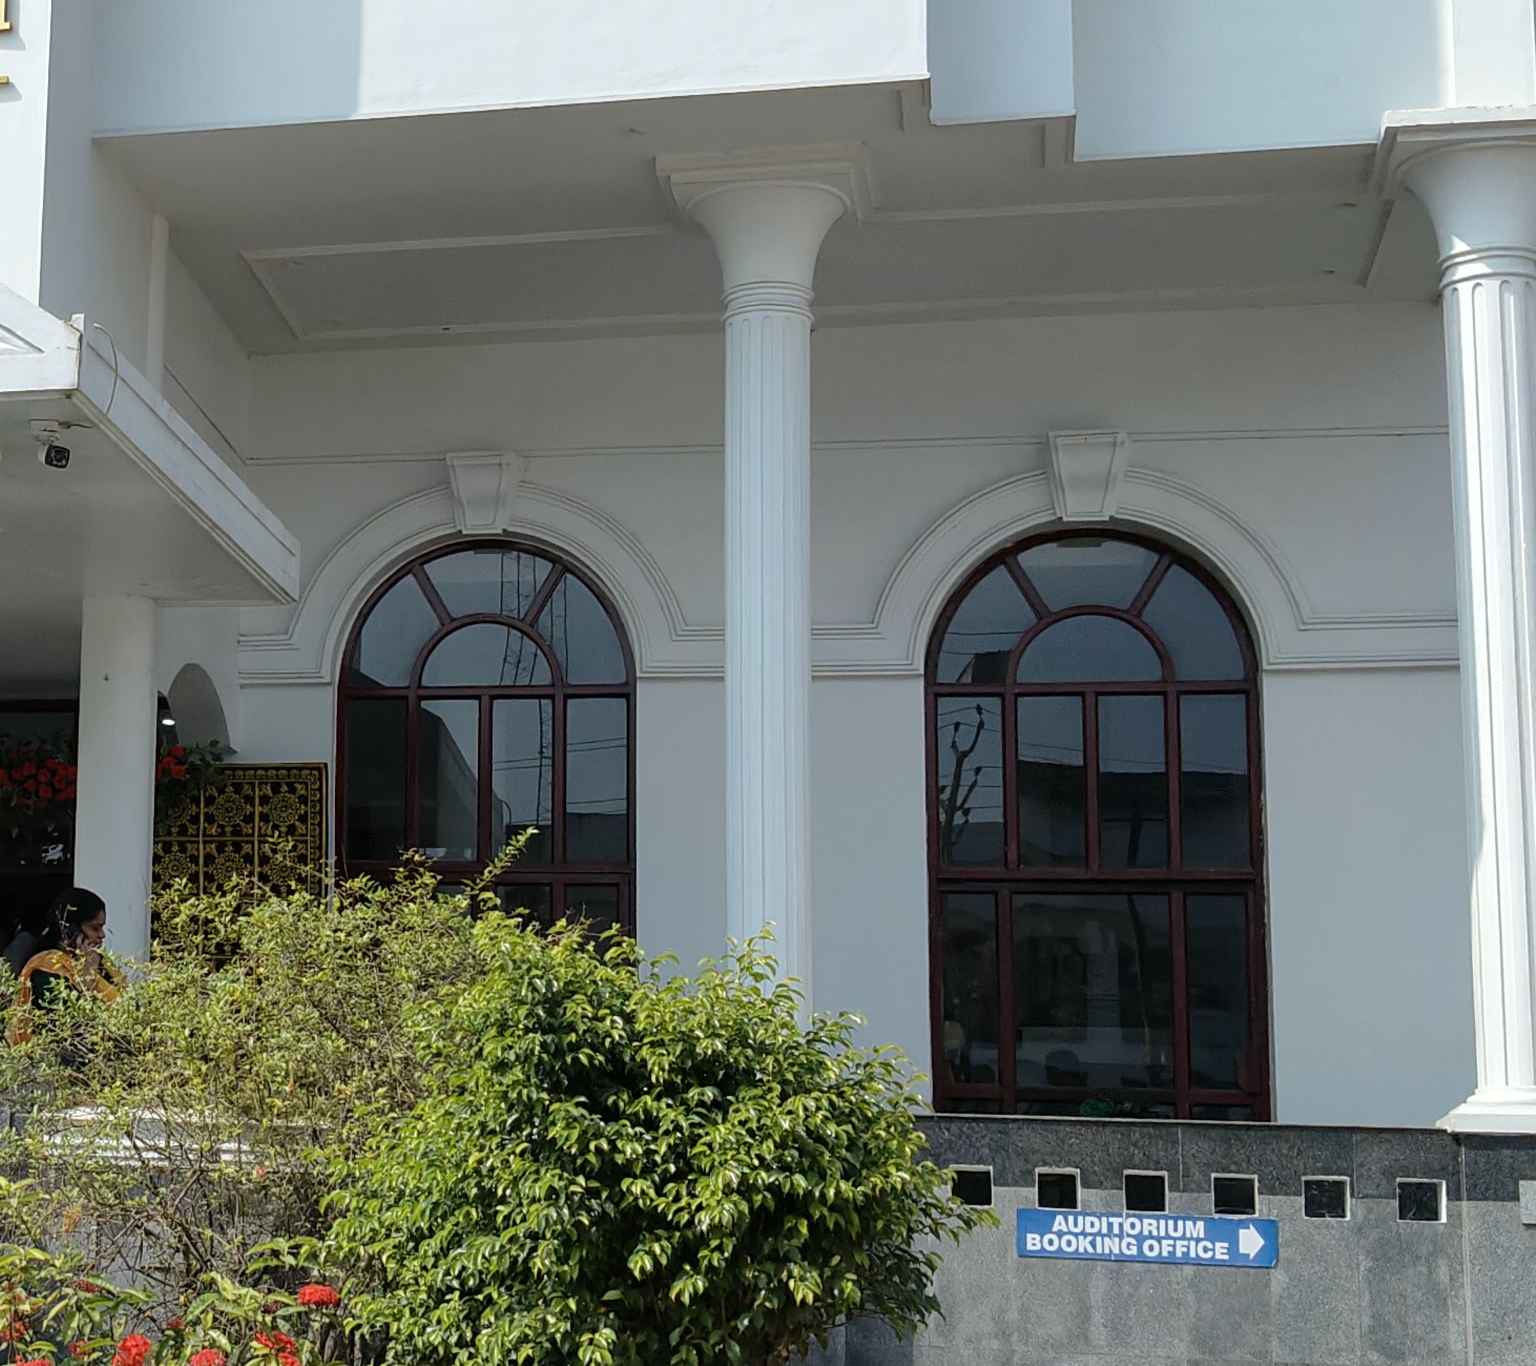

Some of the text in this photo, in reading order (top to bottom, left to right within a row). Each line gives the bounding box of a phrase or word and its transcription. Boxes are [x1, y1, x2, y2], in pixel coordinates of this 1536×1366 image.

[1052, 1215, 1205, 1238] AUDITORIUM
[1026, 1234, 1229, 1260] BOOKING OFFICE
